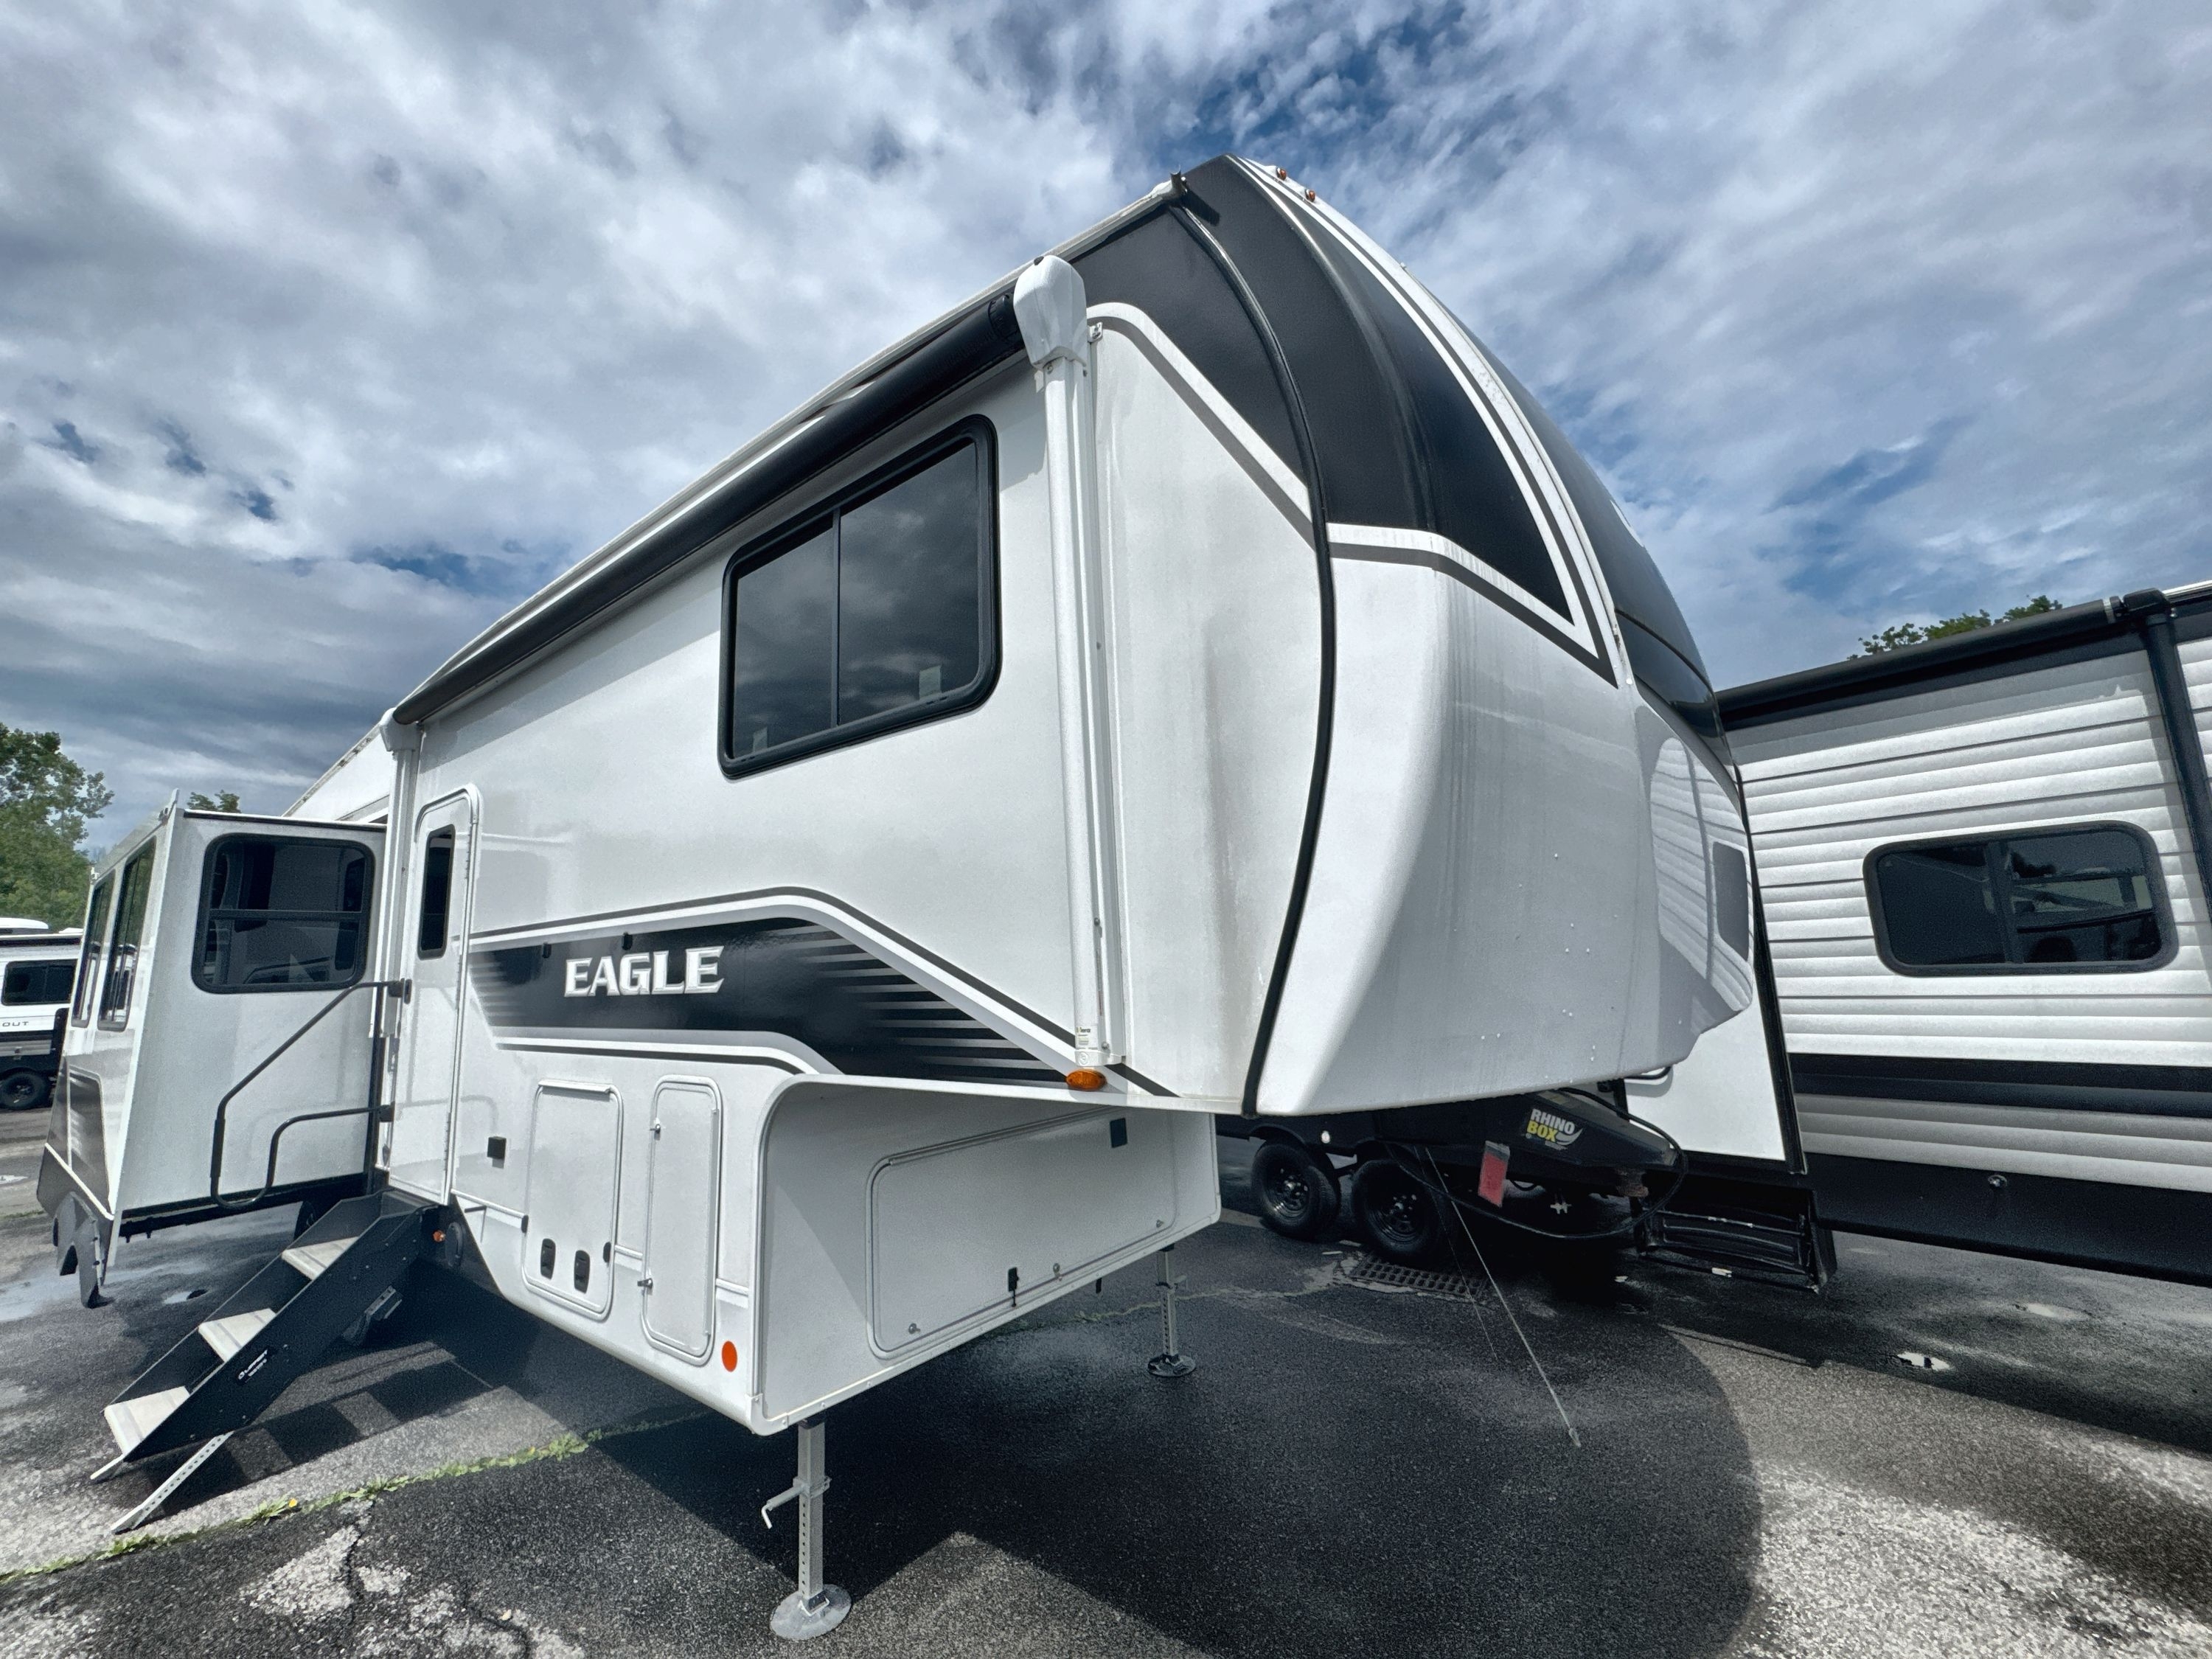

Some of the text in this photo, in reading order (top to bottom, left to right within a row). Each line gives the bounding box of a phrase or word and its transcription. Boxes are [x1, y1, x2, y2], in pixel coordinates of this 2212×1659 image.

[564, 945, 725, 998] EAGLE
[1527, 1121, 1558, 1142] BOX
[1530, 1108, 1575, 1135] RHINO
